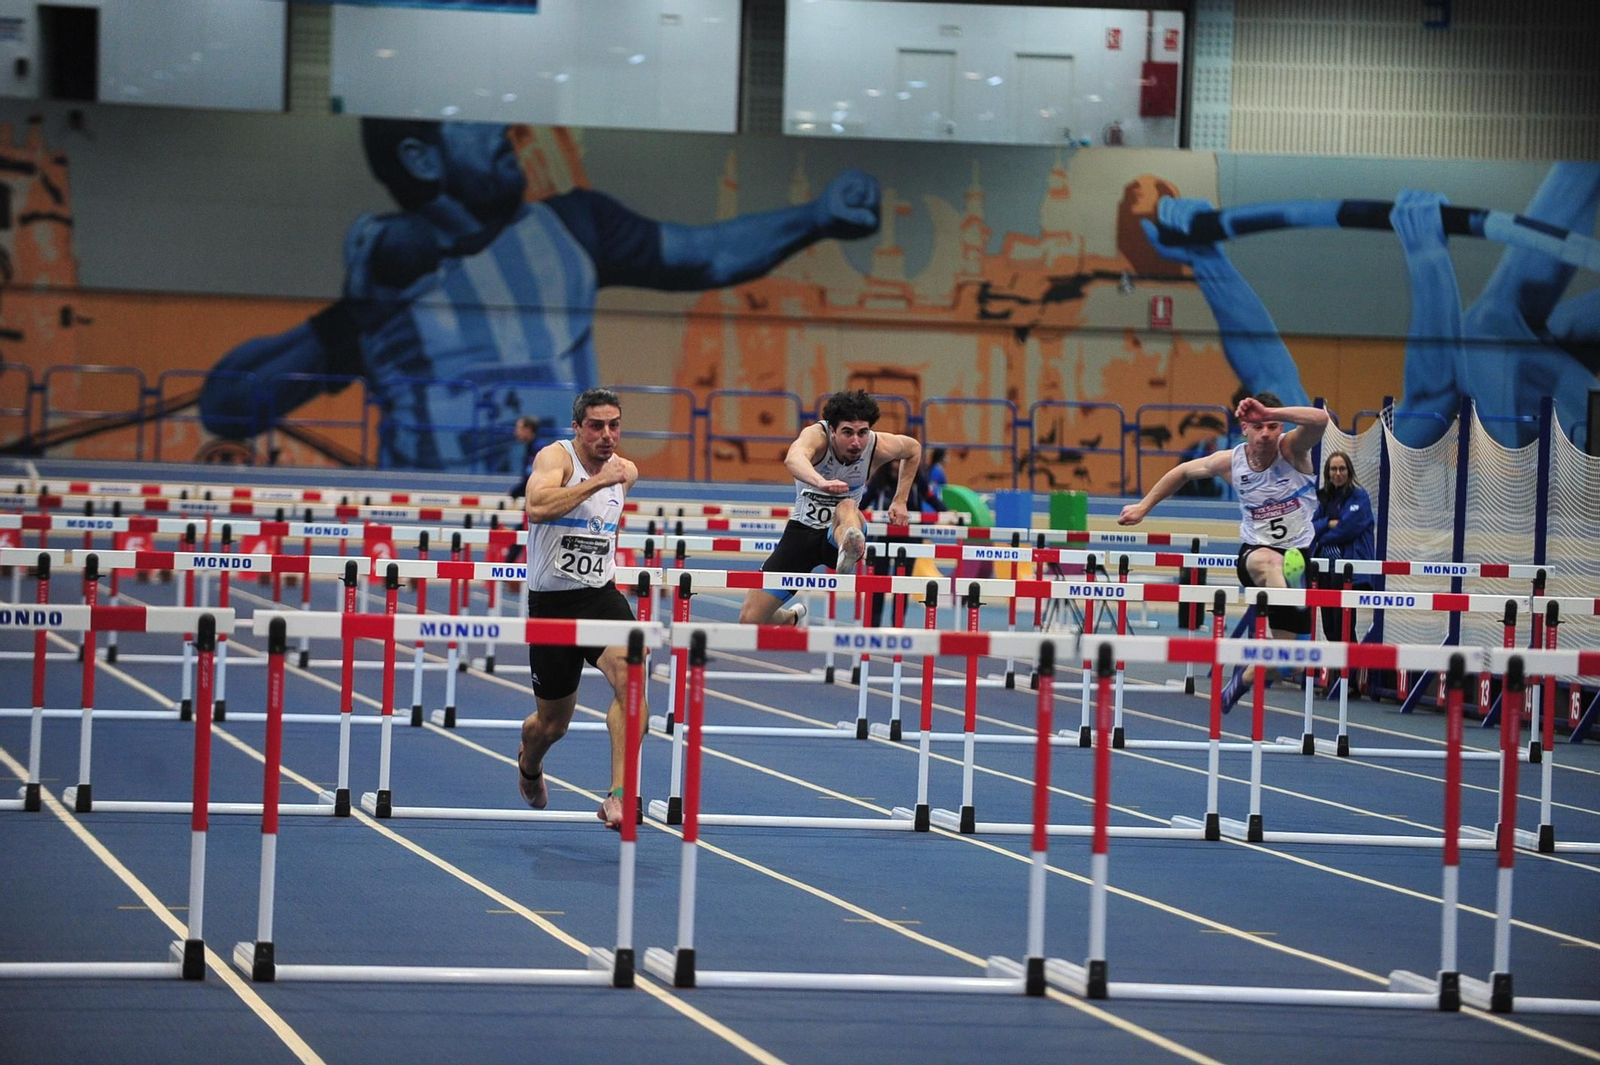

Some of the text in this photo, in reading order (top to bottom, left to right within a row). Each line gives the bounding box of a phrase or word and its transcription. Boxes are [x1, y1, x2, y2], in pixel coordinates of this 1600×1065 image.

[806, 502, 832, 523] 20
[66, 519, 114, 530] MONDO
[1269, 517, 1288, 540] 5
[303, 526, 349, 537] MONDO
[920, 527, 957, 537] MONDO
[1100, 534, 1137, 543] MONDO
[755, 541, 780, 550] MON
[975, 549, 1019, 560] MONDO
[193, 556, 252, 569] MONDO
[560, 552, 604, 577] 204
[491, 567, 527, 579] MON
[1423, 565, 1467, 575] MONDO
[781, 576, 838, 589] MONDO
[1069, 585, 1125, 598] MONDO
[1358, 594, 1416, 607] MONDO
[0, 609, 63, 626] ONDO
[420, 622, 500, 638] MONDO
[834, 633, 913, 650] MONDO
[1243, 645, 1322, 662] MONDO
[1480, 679, 1491, 707] 13
[1570, 691, 1581, 721] 15
